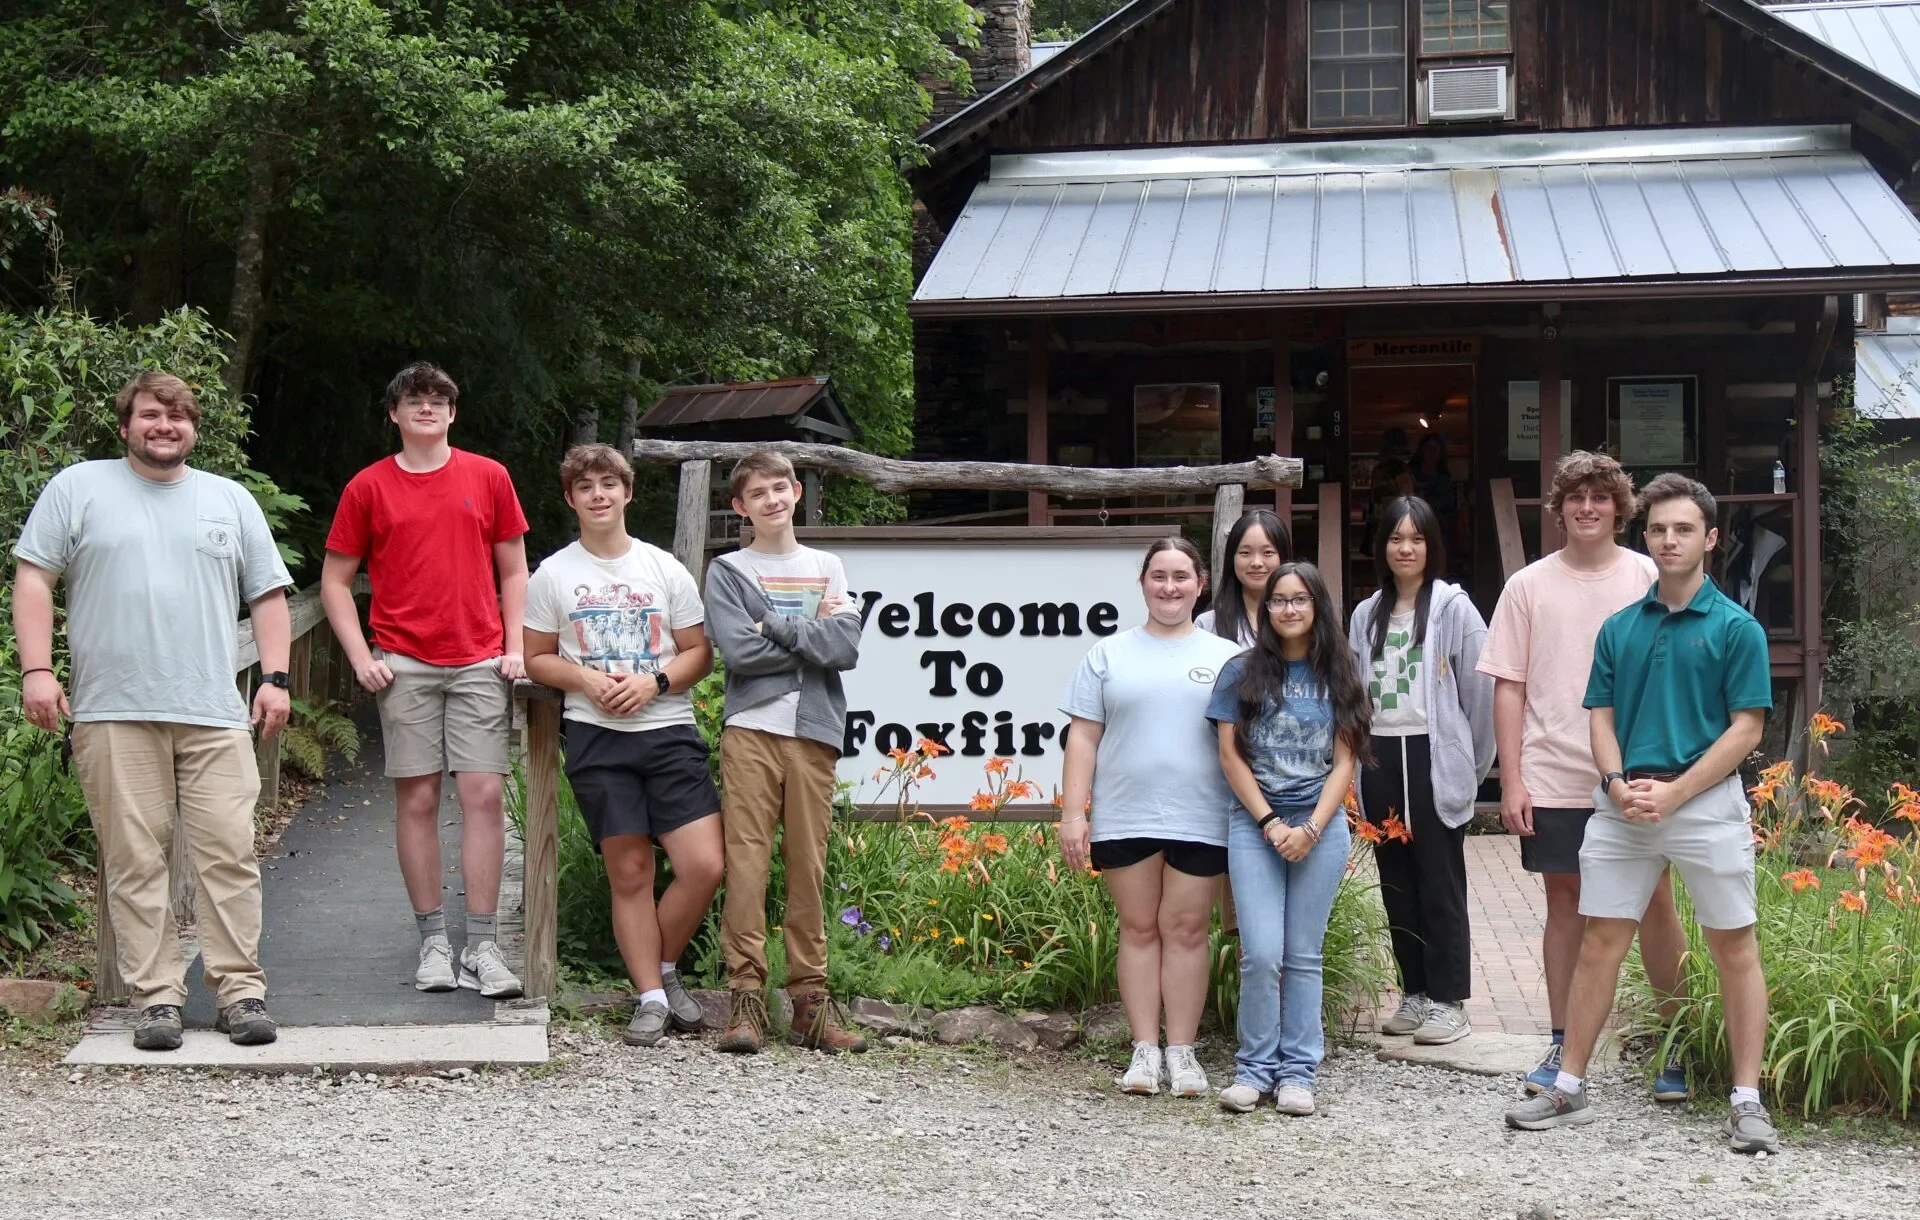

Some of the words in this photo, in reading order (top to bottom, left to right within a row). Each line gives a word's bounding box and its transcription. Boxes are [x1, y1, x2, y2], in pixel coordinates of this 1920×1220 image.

[1373, 340, 1472, 356] Mercantile
[920, 650, 1003, 697] To
[843, 710, 1071, 757] Foxfir
